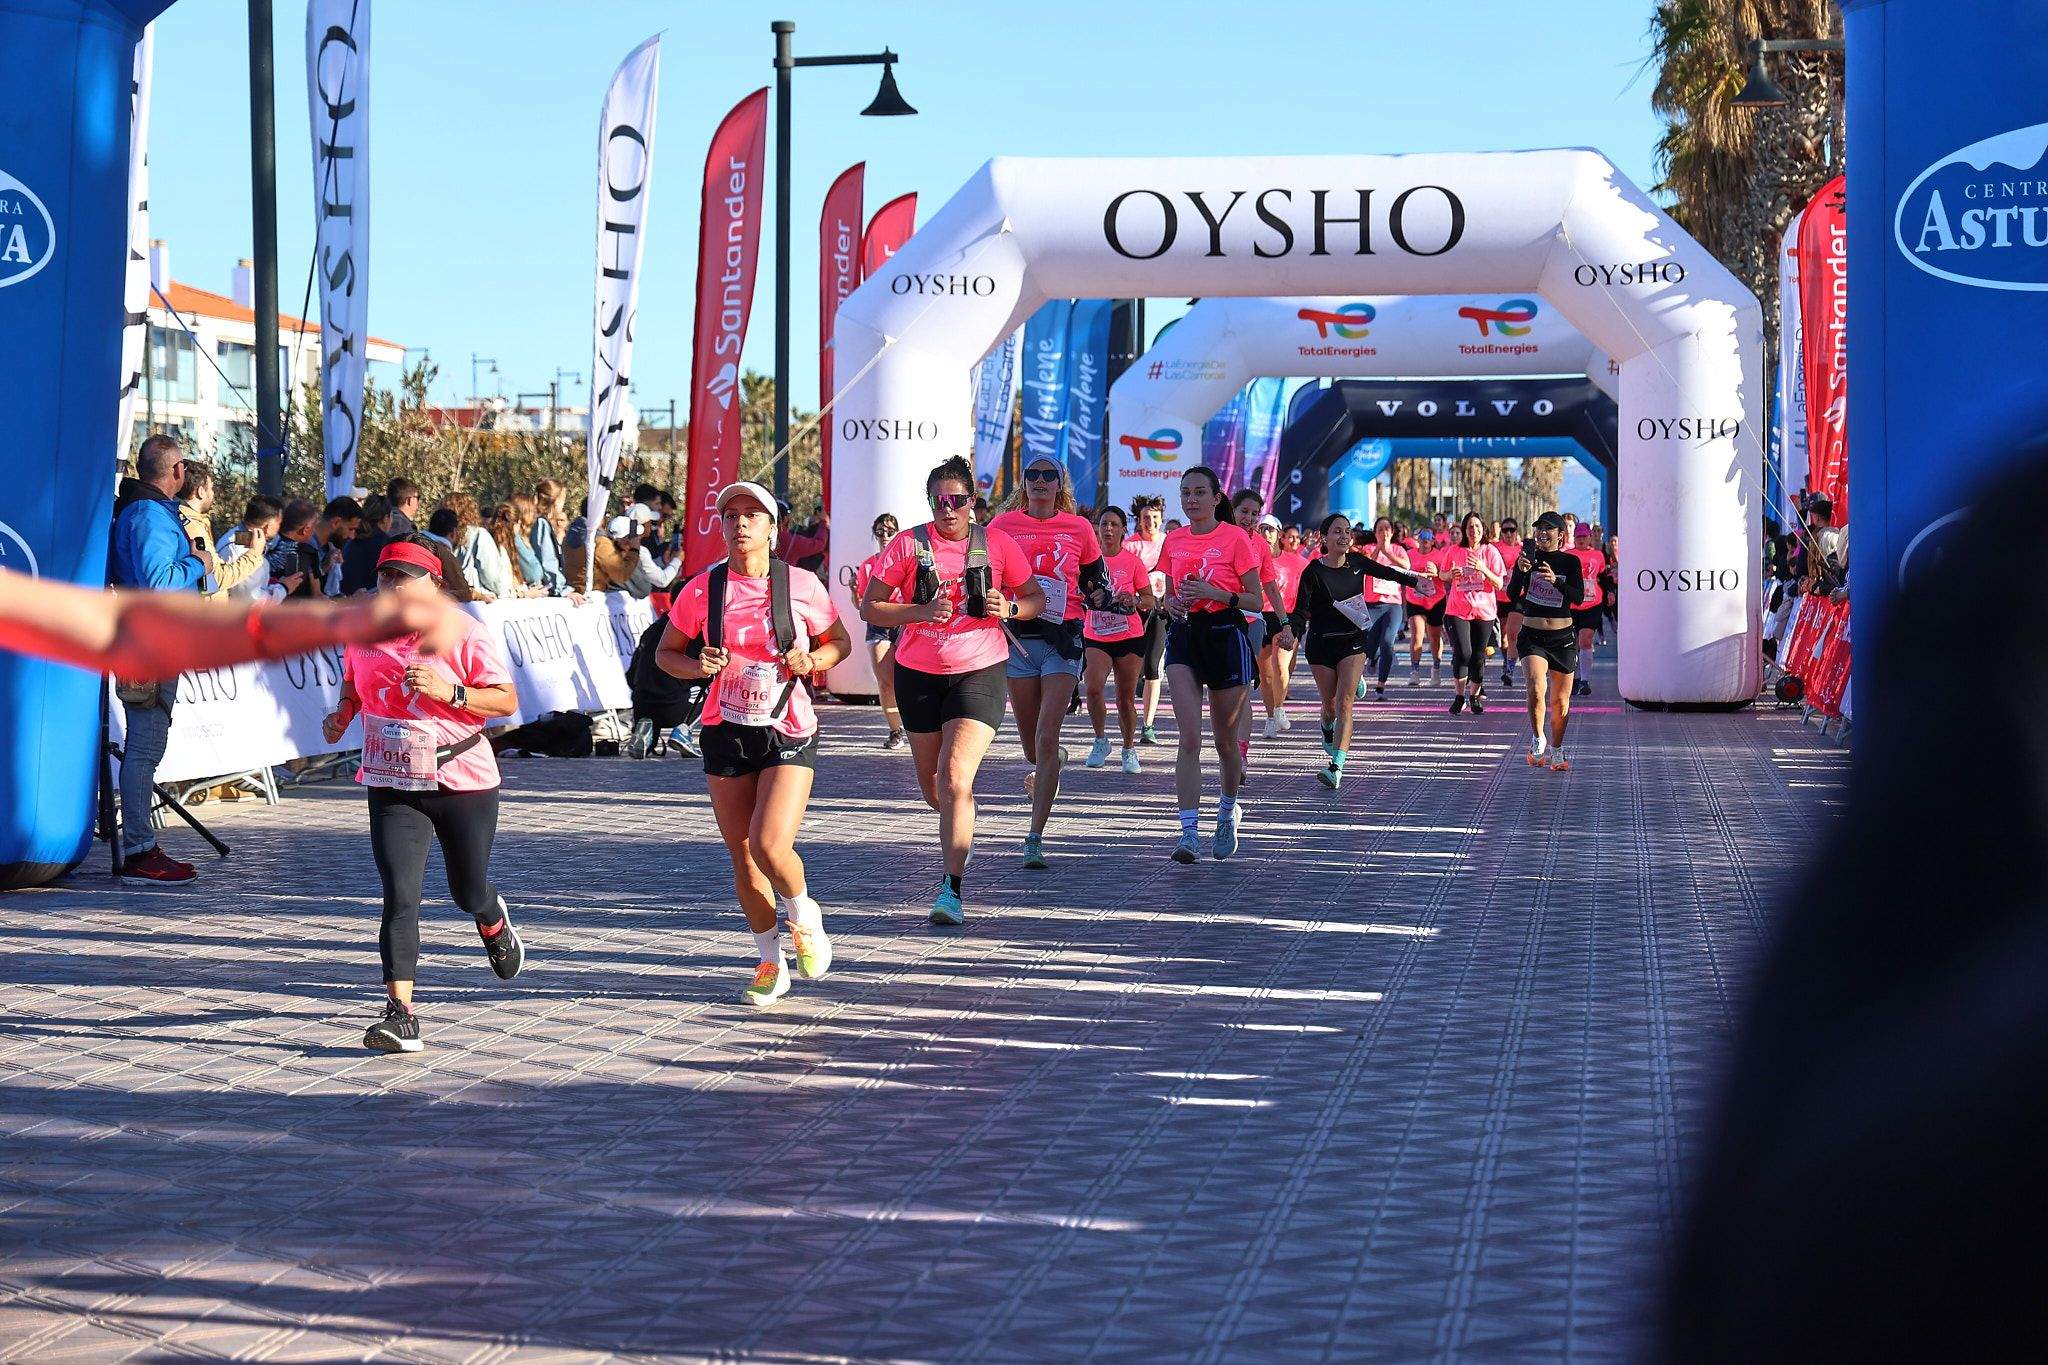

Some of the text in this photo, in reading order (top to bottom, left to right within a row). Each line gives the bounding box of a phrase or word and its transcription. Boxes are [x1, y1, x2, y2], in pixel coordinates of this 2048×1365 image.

[1103, 185, 1465, 259] OYSHO
[715, 157, 746, 355] Santander
[1574, 262, 1685, 286] OYSHO
[891, 274, 996, 297] OYSHO
[1298, 346, 1376, 358] TotalEnergies
[1458, 343, 1538, 355] TotalEnergies
[1023, 338, 1064, 455] Marlene
[1068, 352, 1101, 461] Marlene
[1376, 400, 1554, 417] VOLVO
[842, 419, 938, 441] OYSHO
[1637, 418, 1740, 440] OYSHO
[1118, 469, 1182, 480] TotalEnergies
[1637, 569, 1739, 591] OYSHO
[503, 613, 574, 668] OYSHO
[741, 690, 768, 701] 016
[383, 750, 411, 763] 016
